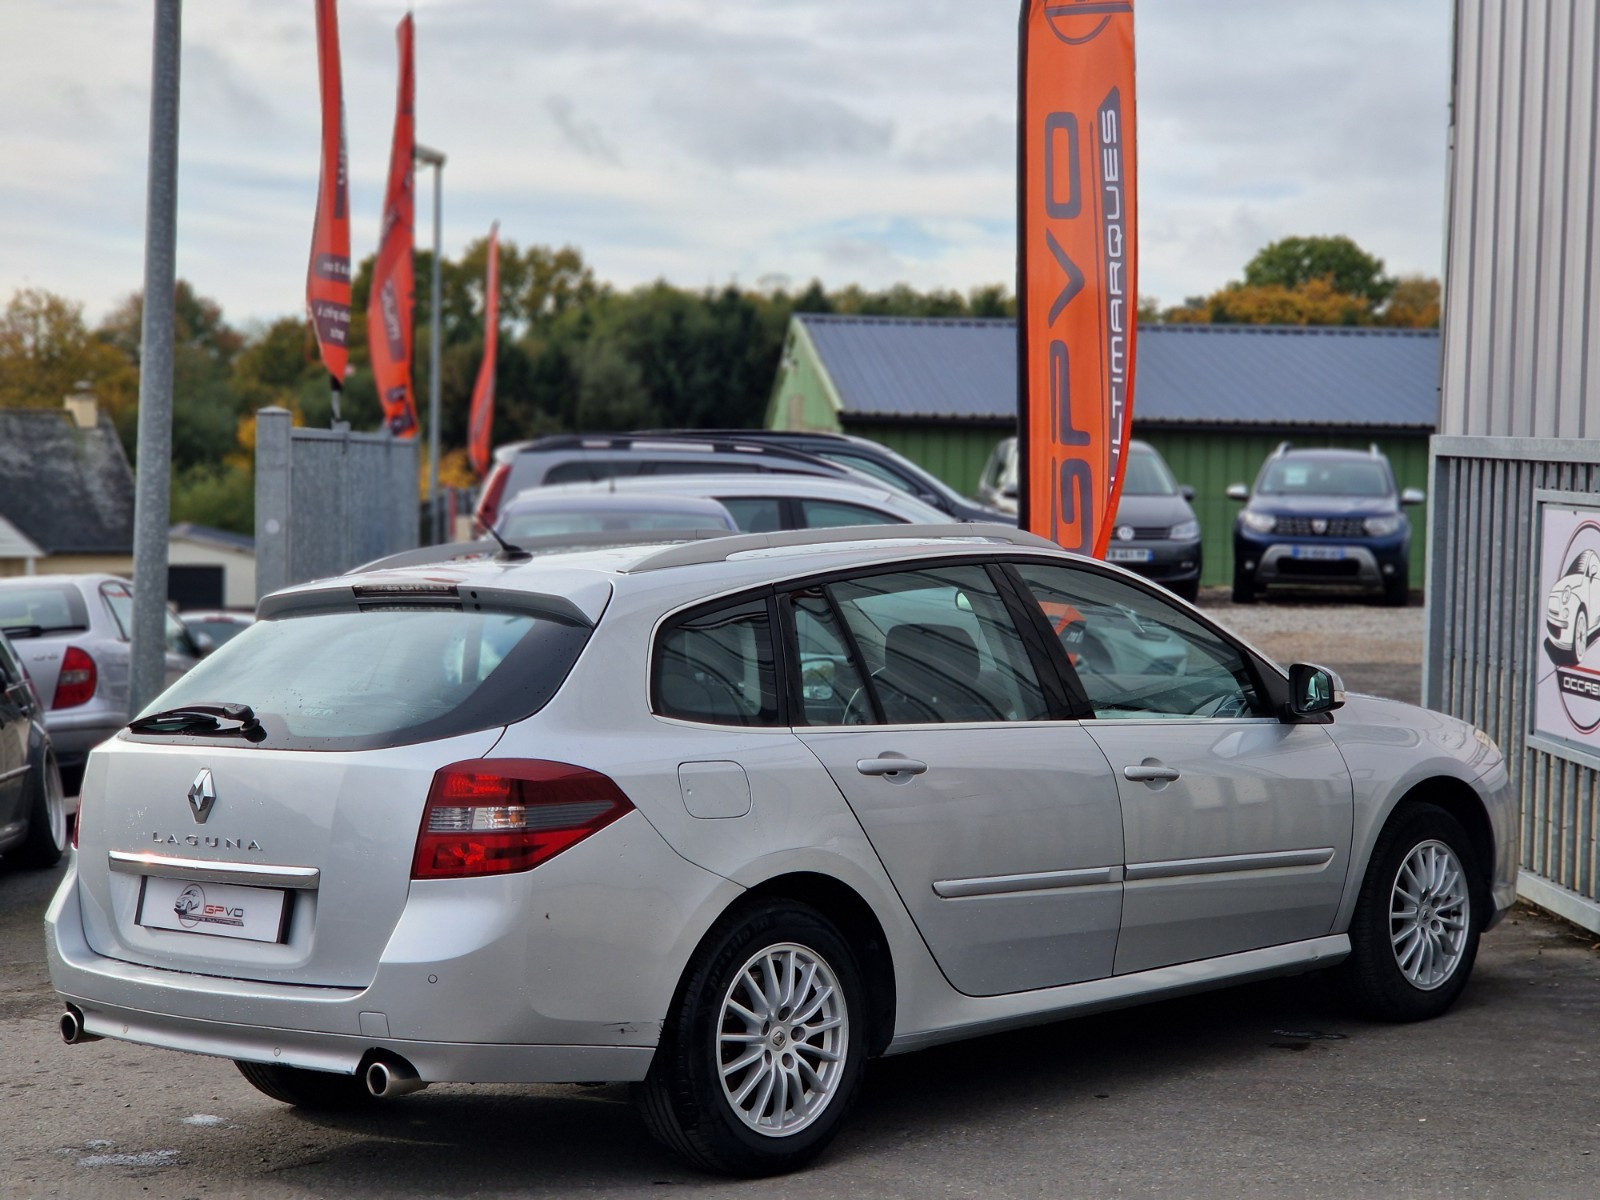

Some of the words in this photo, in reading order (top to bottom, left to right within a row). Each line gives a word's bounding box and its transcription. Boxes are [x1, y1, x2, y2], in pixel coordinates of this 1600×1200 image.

[1044, 111, 1092, 558] GPVO
[1102, 109, 1124, 496] LTIMARQUES
[152, 832, 263, 851] LAGUNA
[204, 904, 244, 918] GPVO
